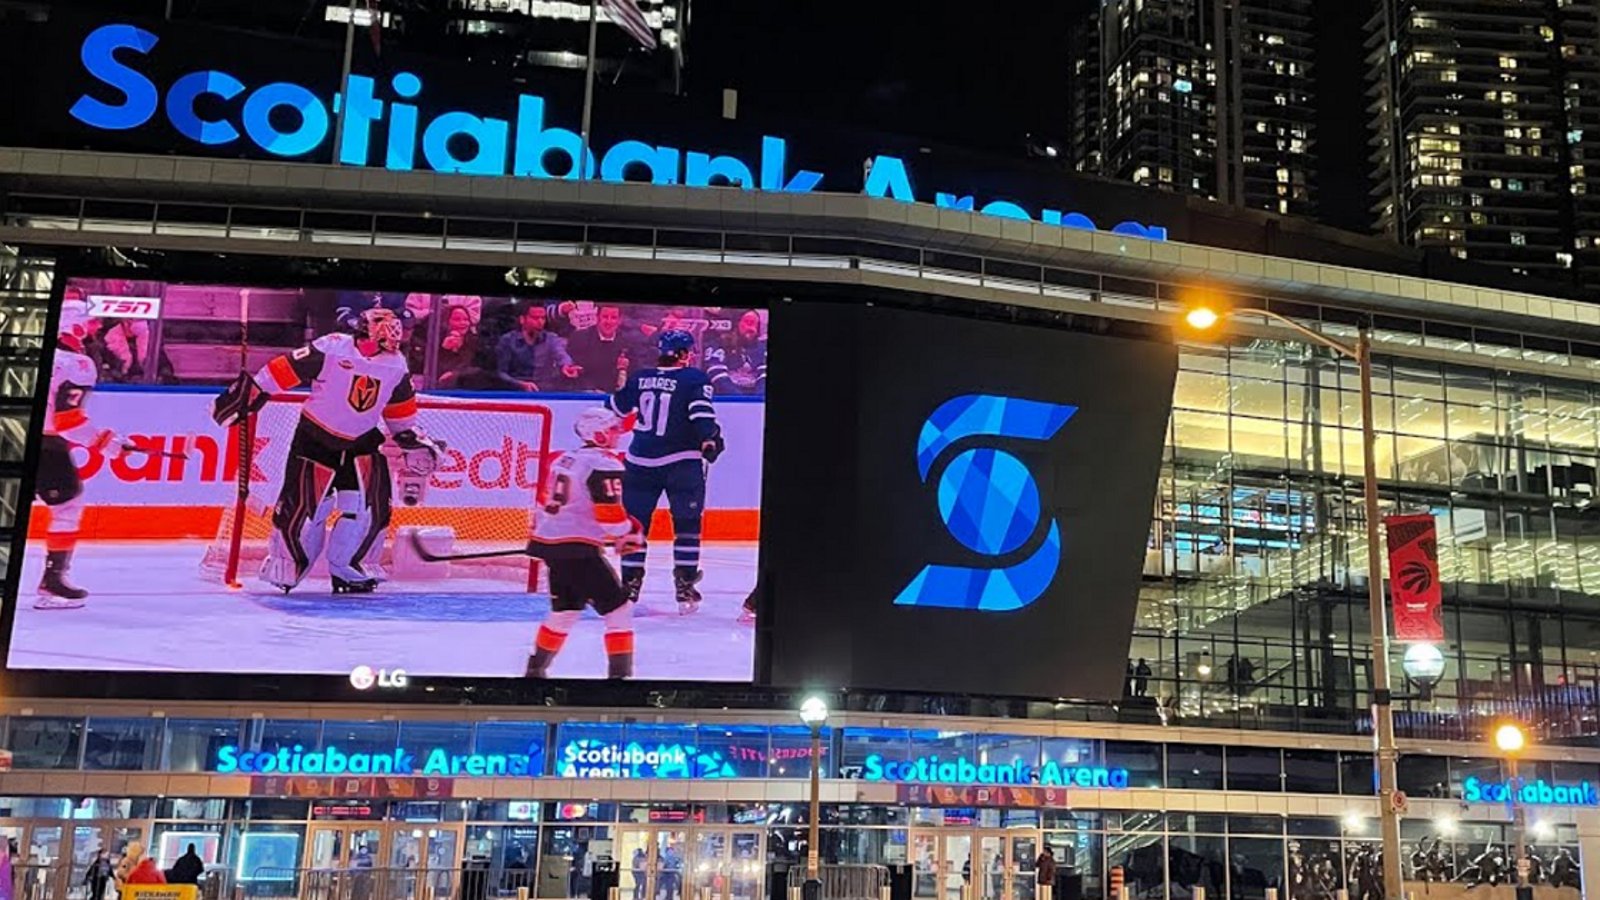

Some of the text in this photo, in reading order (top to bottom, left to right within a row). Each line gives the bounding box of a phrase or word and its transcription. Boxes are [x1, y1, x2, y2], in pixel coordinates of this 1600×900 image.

[68, 23, 824, 192] Scotiabank
[102, 299, 152, 314] TSN
[638, 377, 678, 391] TAVARES
[634, 391, 672, 436] 91
[378, 668, 407, 688] LG
[217, 744, 530, 777] Scotiabank Arena
[564, 744, 686, 765] Scotiabank
[865, 754, 1031, 784] Scotiabank
[1040, 760, 1129, 788] Arena
